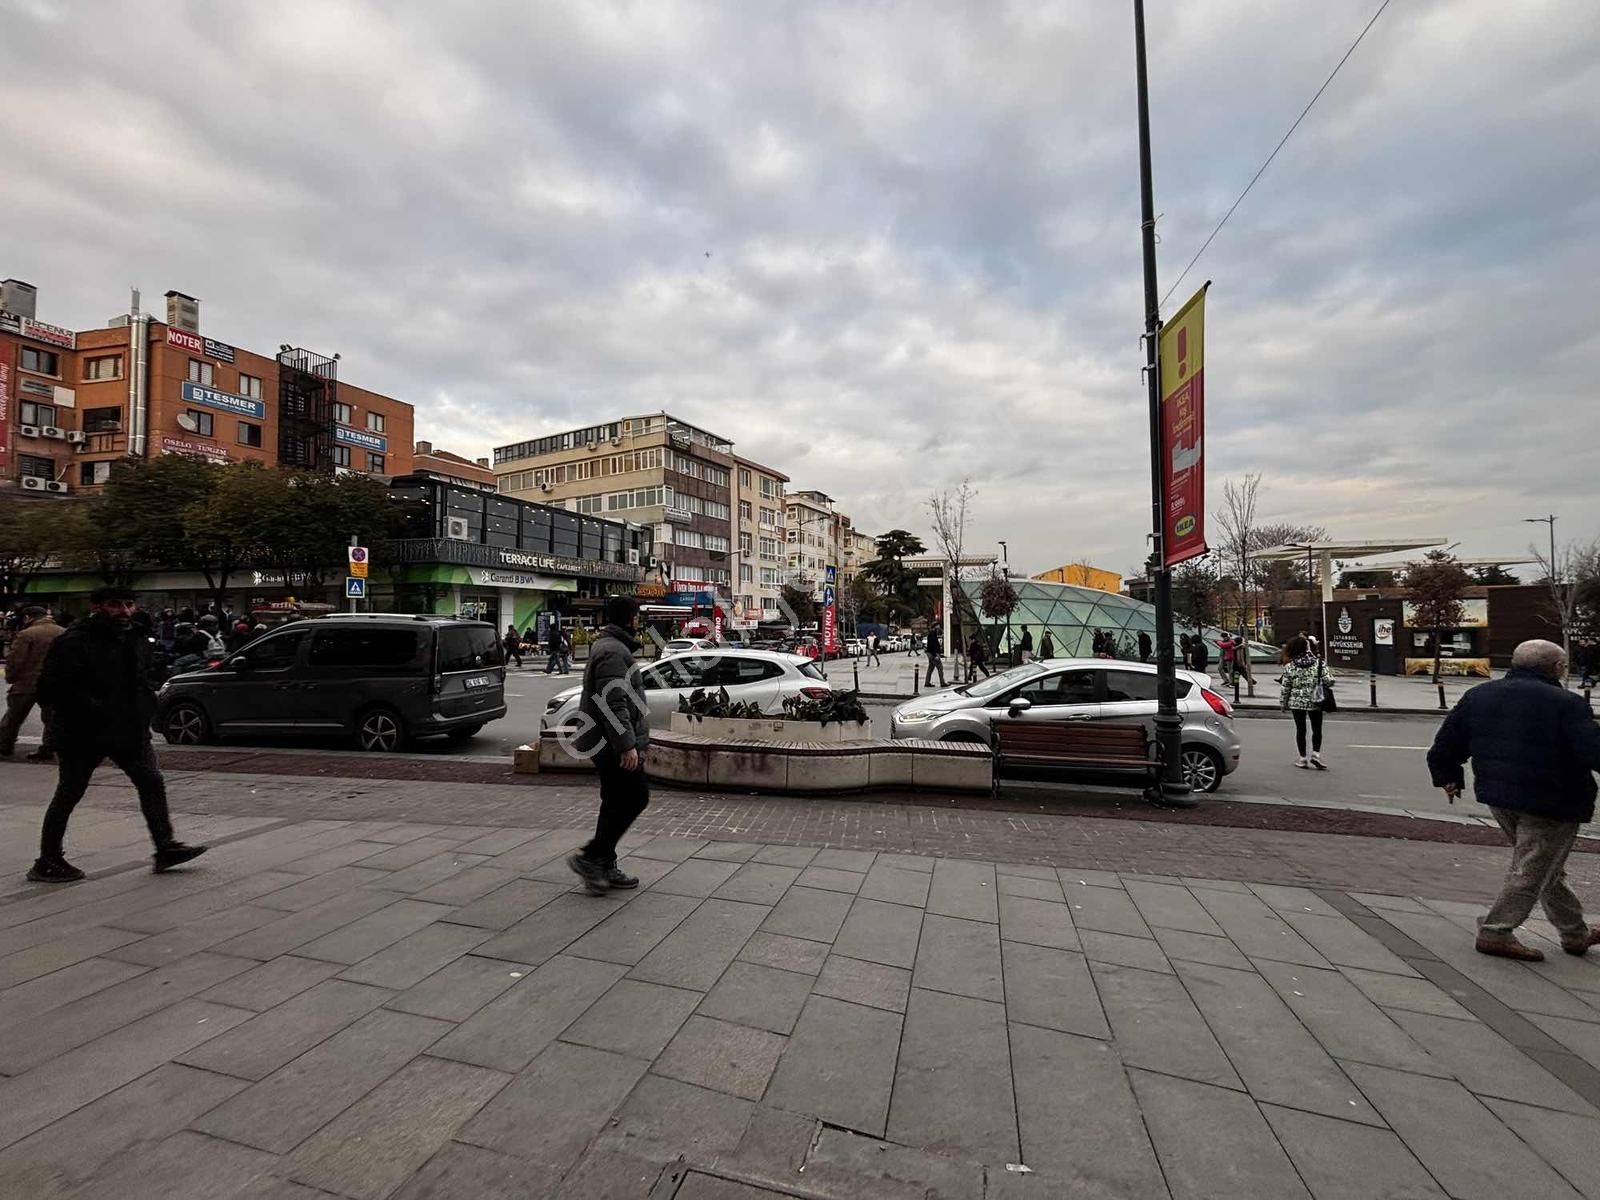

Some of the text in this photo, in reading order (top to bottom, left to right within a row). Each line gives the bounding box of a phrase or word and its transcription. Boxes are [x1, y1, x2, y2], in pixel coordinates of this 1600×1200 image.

[168, 331, 201, 350] NOTER
[204, 390, 256, 411] TESMER
[345, 430, 381, 445] TESMER
[1177, 519, 1193, 532] IKEA
[500, 552, 538, 567] TERRACE
[539, 557, 555, 569] LIFE
[491, 573, 535, 584] Garanti BBVA
[825, 611, 833, 647] MOTRIO
